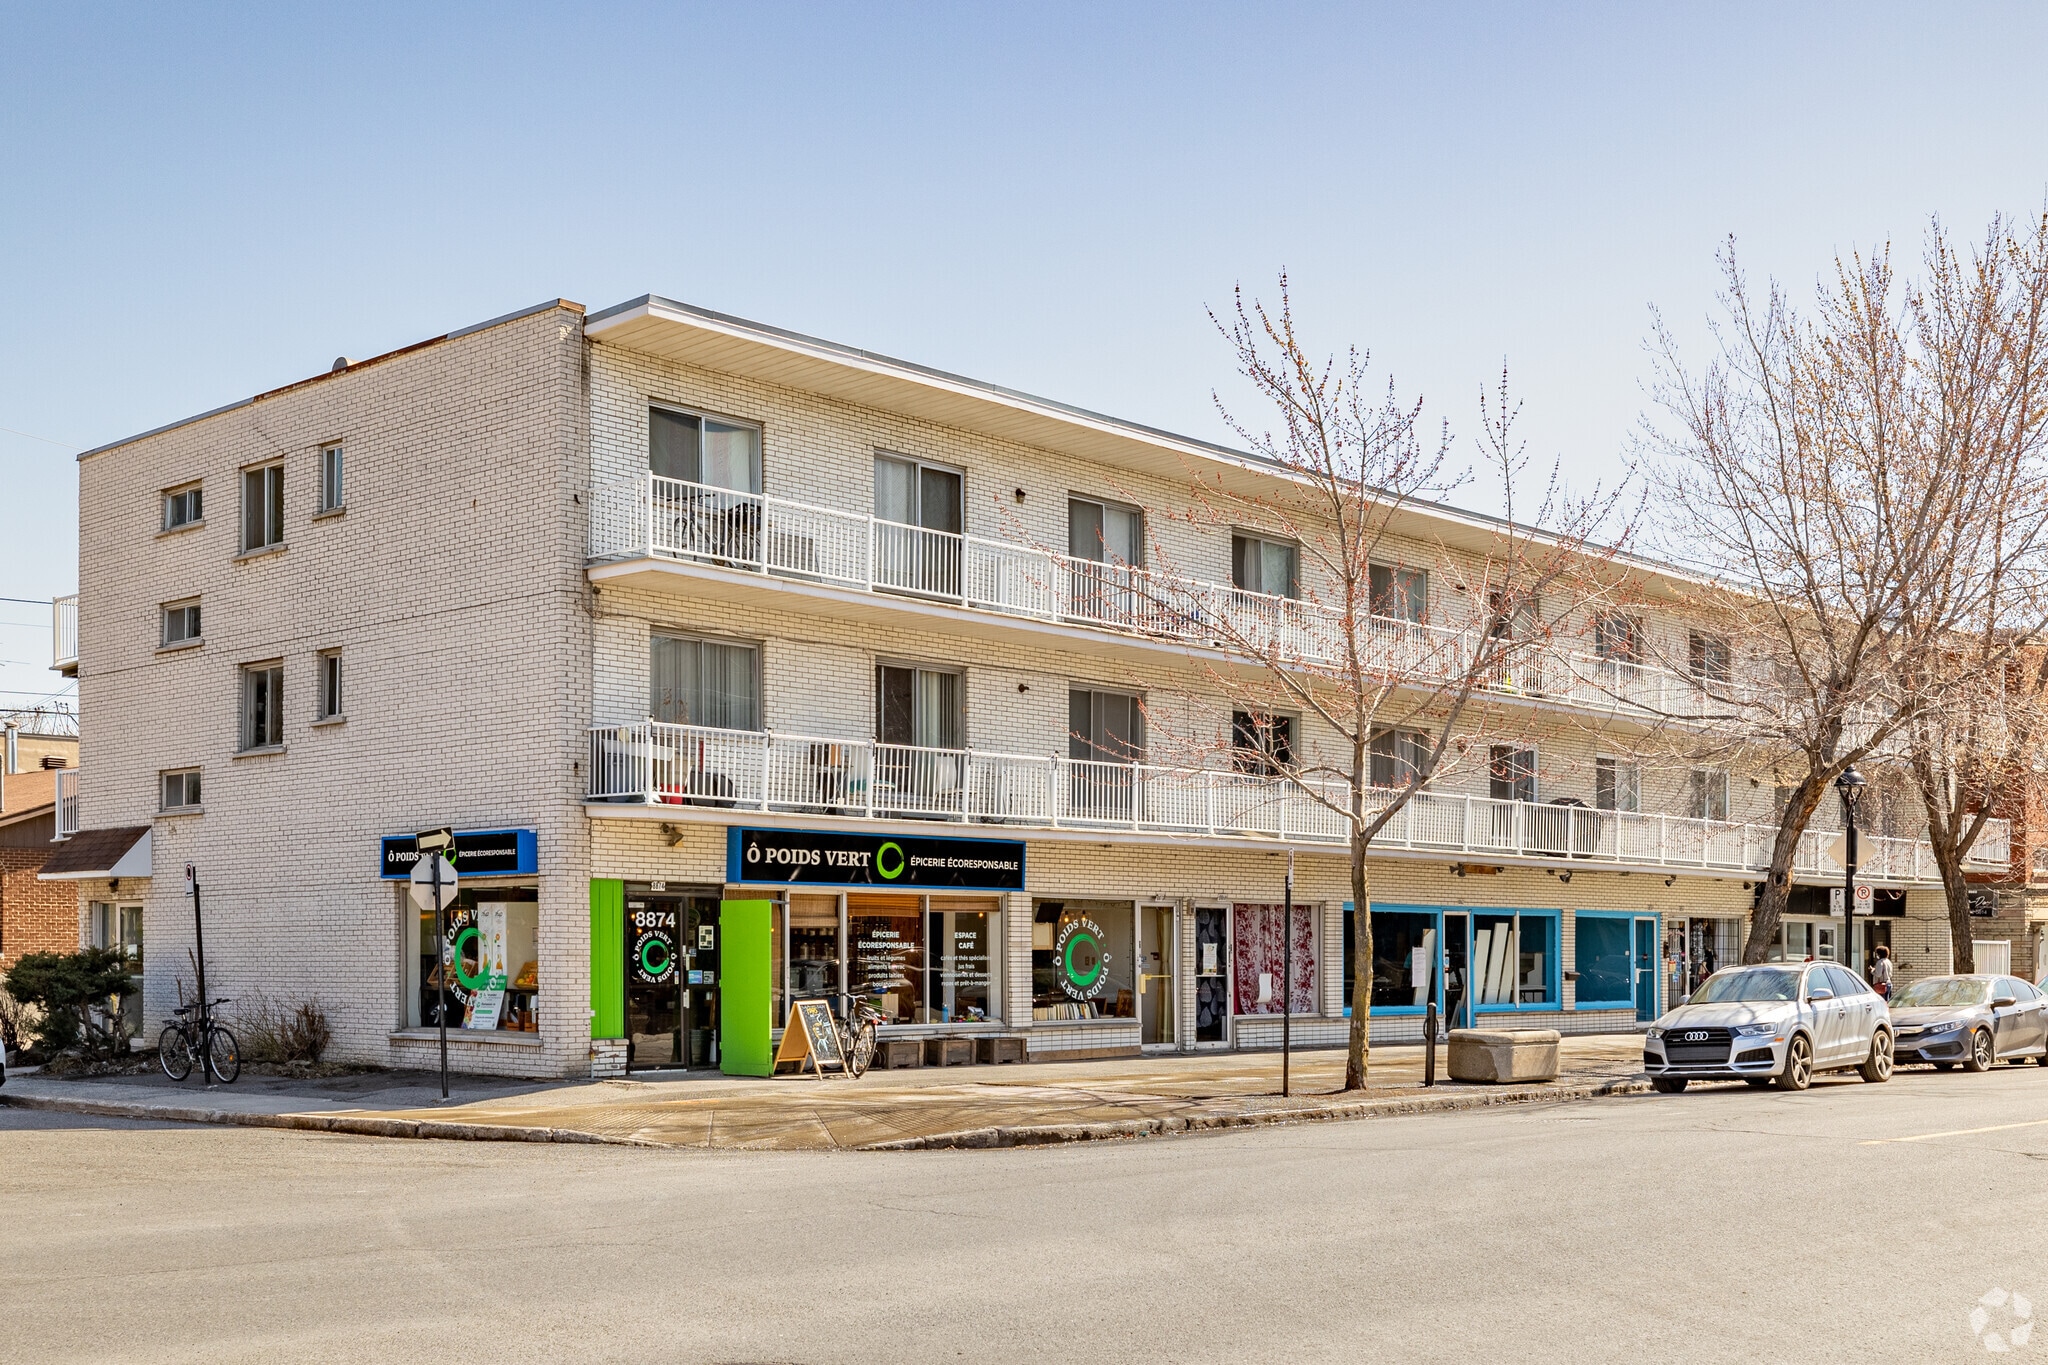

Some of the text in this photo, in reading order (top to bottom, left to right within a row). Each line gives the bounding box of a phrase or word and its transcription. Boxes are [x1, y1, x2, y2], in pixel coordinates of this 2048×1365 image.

[389, 850, 395, 862] Ô
[396, 852, 419, 862] POIDS
[477, 848, 516, 856] ÉCORESPONSABLE
[747, 842, 871, 866] Ô POIDS VERT
[911, 855, 1018, 870] ÉPICERIE ÉCORESPONSABLE
[1835, 890, 1841, 899] P
[635, 912, 676, 928] 8874
[635, 931, 653, 952] POIDS
[655, 931, 672, 945] VERT
[872, 930, 900, 938] ÉPICERIE
[858, 940, 915, 949] ÉCORESPONSABLE
[958, 941, 974, 949] CAFÉ
[1053, 919, 1104, 967] Ô POIDS VERT
[638, 969, 656, 984] VERT
[658, 962, 675, 983] POIDS
[1060, 952, 1112, 1001] Ô POIDS VERT
